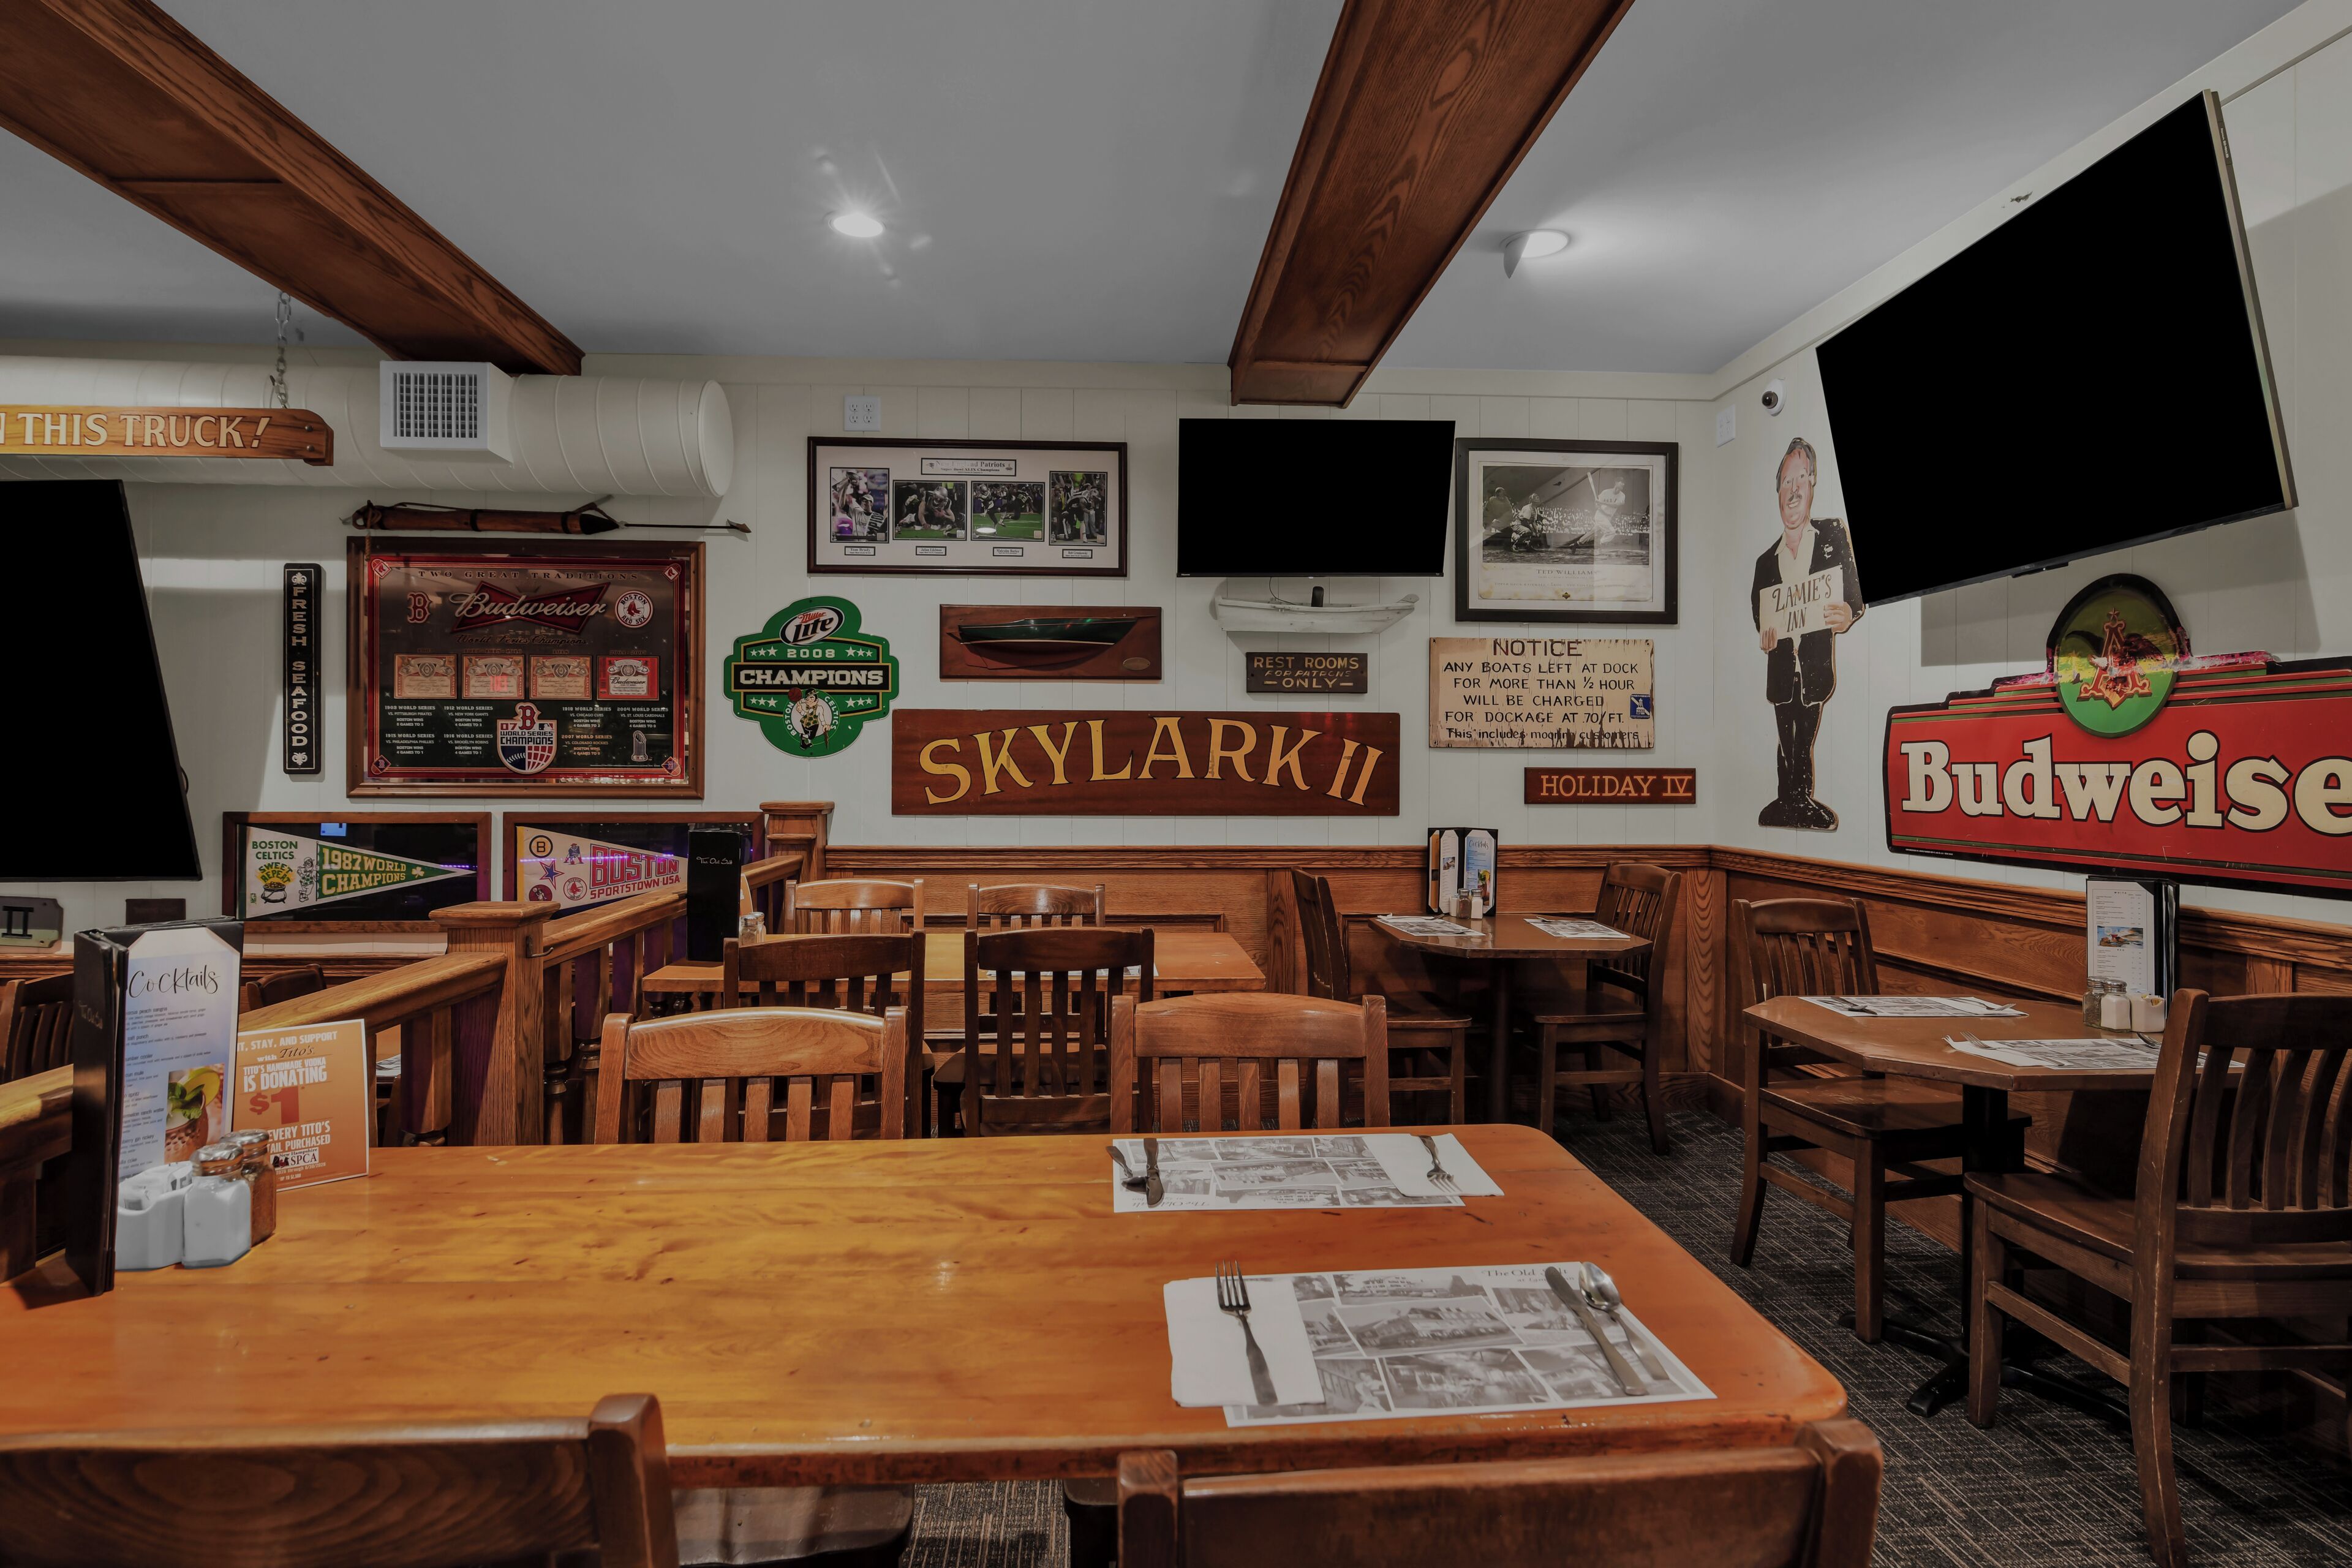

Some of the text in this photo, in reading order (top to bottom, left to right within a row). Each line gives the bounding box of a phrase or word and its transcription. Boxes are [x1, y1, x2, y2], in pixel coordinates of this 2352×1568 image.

[17, 413, 108, 446] THIS
[119, 415, 273, 448] TRUCK!
[407, 591, 432, 624] B
[449, 592, 607, 617] Budweiser
[620, 594, 647, 606] BOSTON
[292, 586, 307, 646] FRESH
[622, 615, 632, 624] RED
[798, 612, 827, 624] Miller
[1787, 607, 1807, 632] INN
[791, 617, 834, 645] Lite
[456, 634, 491, 643] World
[532, 635, 587, 647] Champions
[1493, 640, 1582, 657] NOTICE
[787, 649, 835, 658] 2008
[1254, 657, 1359, 669] REST ROOMS
[1444, 662, 1638, 674] ANY BOATS LEFT AT DOCK
[739, 669, 884, 685] CHAMPIONS
[1282, 678, 1338, 688] ONLY
[1454, 678, 1480, 688] FOR
[1490, 678, 1529, 689] MORE
[1537, 679, 1576, 690] THAN
[1599, 680, 1635, 690] HOUR
[291, 661, 308, 747] SEAFOOD
[1463, 695, 1604, 707] WILL BE CHARGED
[519, 706, 536, 730] B
[785, 696, 839, 736] BOSTON CELTICS
[1445, 712, 1474, 722] FOR
[1485, 712, 1553, 723] DOCKAGE
[1562, 712, 1578, 723] AT
[1446, 728, 1472, 739] This
[1479, 728, 1526, 739] includes
[919, 715, 1386, 807] SKYLARK II
[1540, 775, 1692, 796] HOLIDAY IV
[537, 842, 545, 852] B
[258, 862, 293, 874] SWEET
[322, 848, 407, 872] 1987 WORLD
[590, 843, 679, 889] BOSTON
[260, 870, 290, 883] REPEAT
[322, 872, 406, 895] CHAMPIONS
[590, 878, 660, 899] SPORTSTOWN
[129, 965, 221, 998] Cocktails
[251, 1039, 276, 1050] STAY,
[280, 1036, 297, 1046] AND
[300, 1031, 337, 1044] SUPPORT
[279, 1046, 315, 1058] Tito's
[244, 1057, 326, 1075] TITO'S HANDMADE VODKA
[244, 1066, 327, 1093] IS DONATING
[268, 1120, 330, 1142] EVERY TITO'S
[285, 1134, 330, 1150] PURCHASED
[291, 1153, 317, 1166] SPCA
